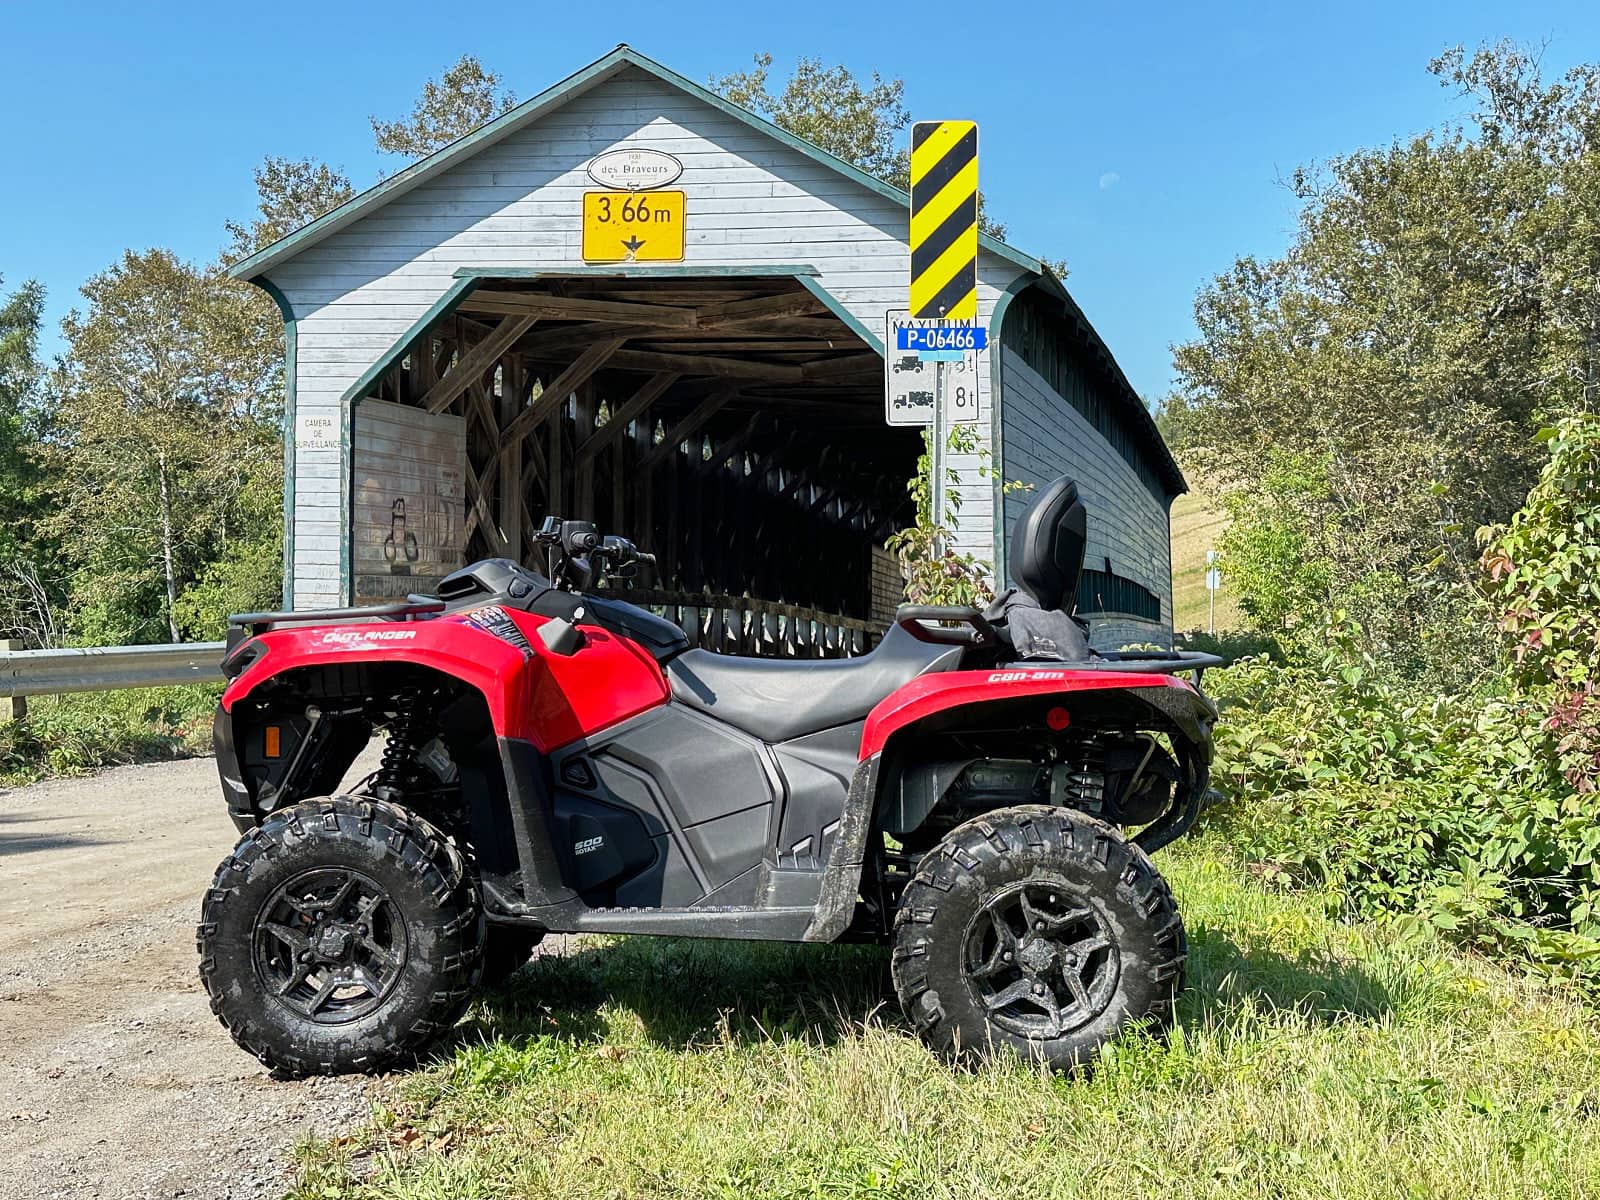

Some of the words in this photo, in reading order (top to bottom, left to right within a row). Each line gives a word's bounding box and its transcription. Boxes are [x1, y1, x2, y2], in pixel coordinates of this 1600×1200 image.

[601, 164, 618, 174] des
[907, 329, 975, 349] P-06466
[322, 630, 417, 643] OUTLANDER
[574, 835, 603, 850] 500
